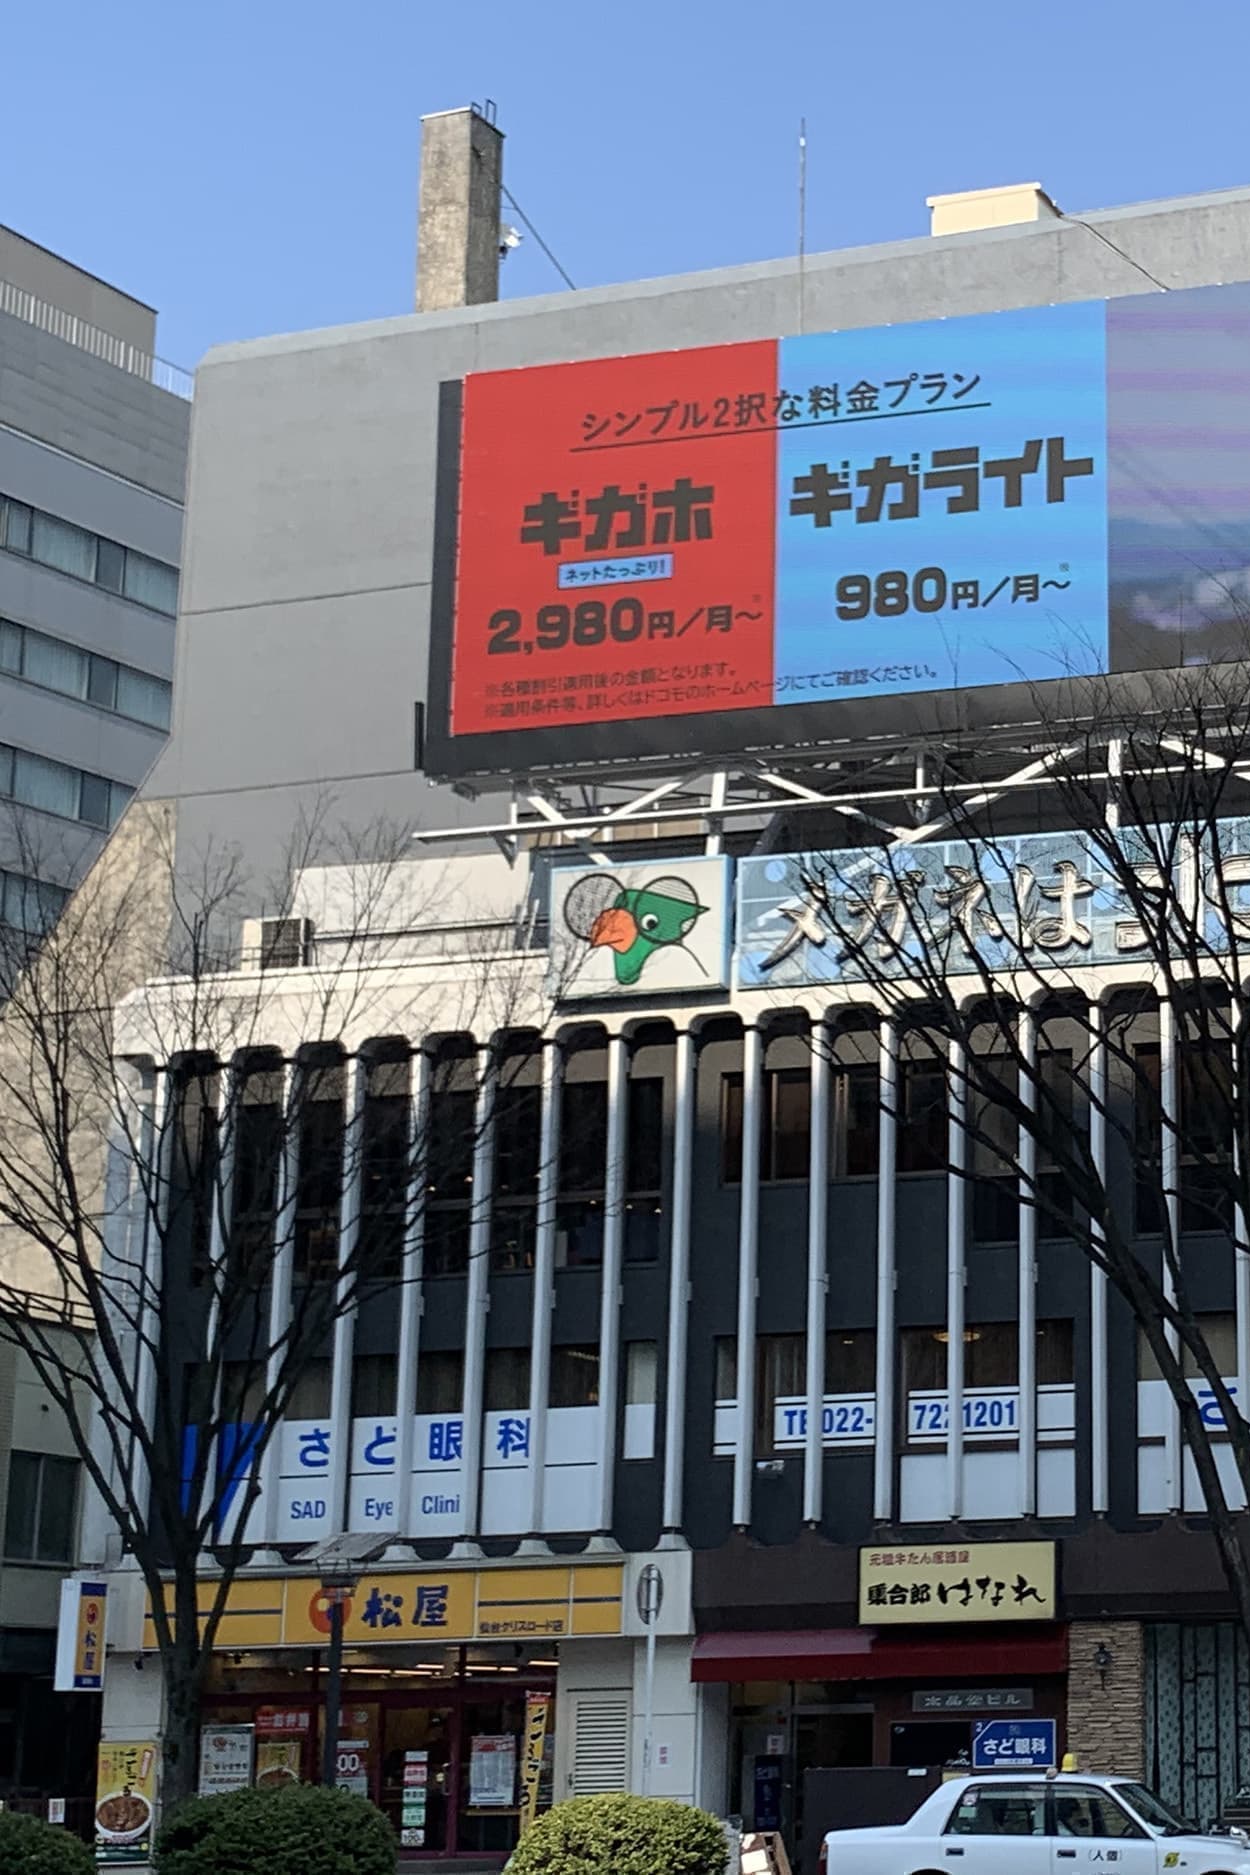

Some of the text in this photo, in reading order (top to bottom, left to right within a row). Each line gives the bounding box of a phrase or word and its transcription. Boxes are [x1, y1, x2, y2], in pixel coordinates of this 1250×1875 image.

[580, 372, 983, 441] シンプル2択な料金プラン
[789, 436, 1094, 528] ギガライト
[520, 477, 714, 556] ギガホ
[299, 1417, 531, 1467] さど眼科
[290, 1493, 461, 1520] SAD Eye Clini
[361, 1584, 450, 1629] 松屋
[983, 1737, 1047, 1756] さど眼科
